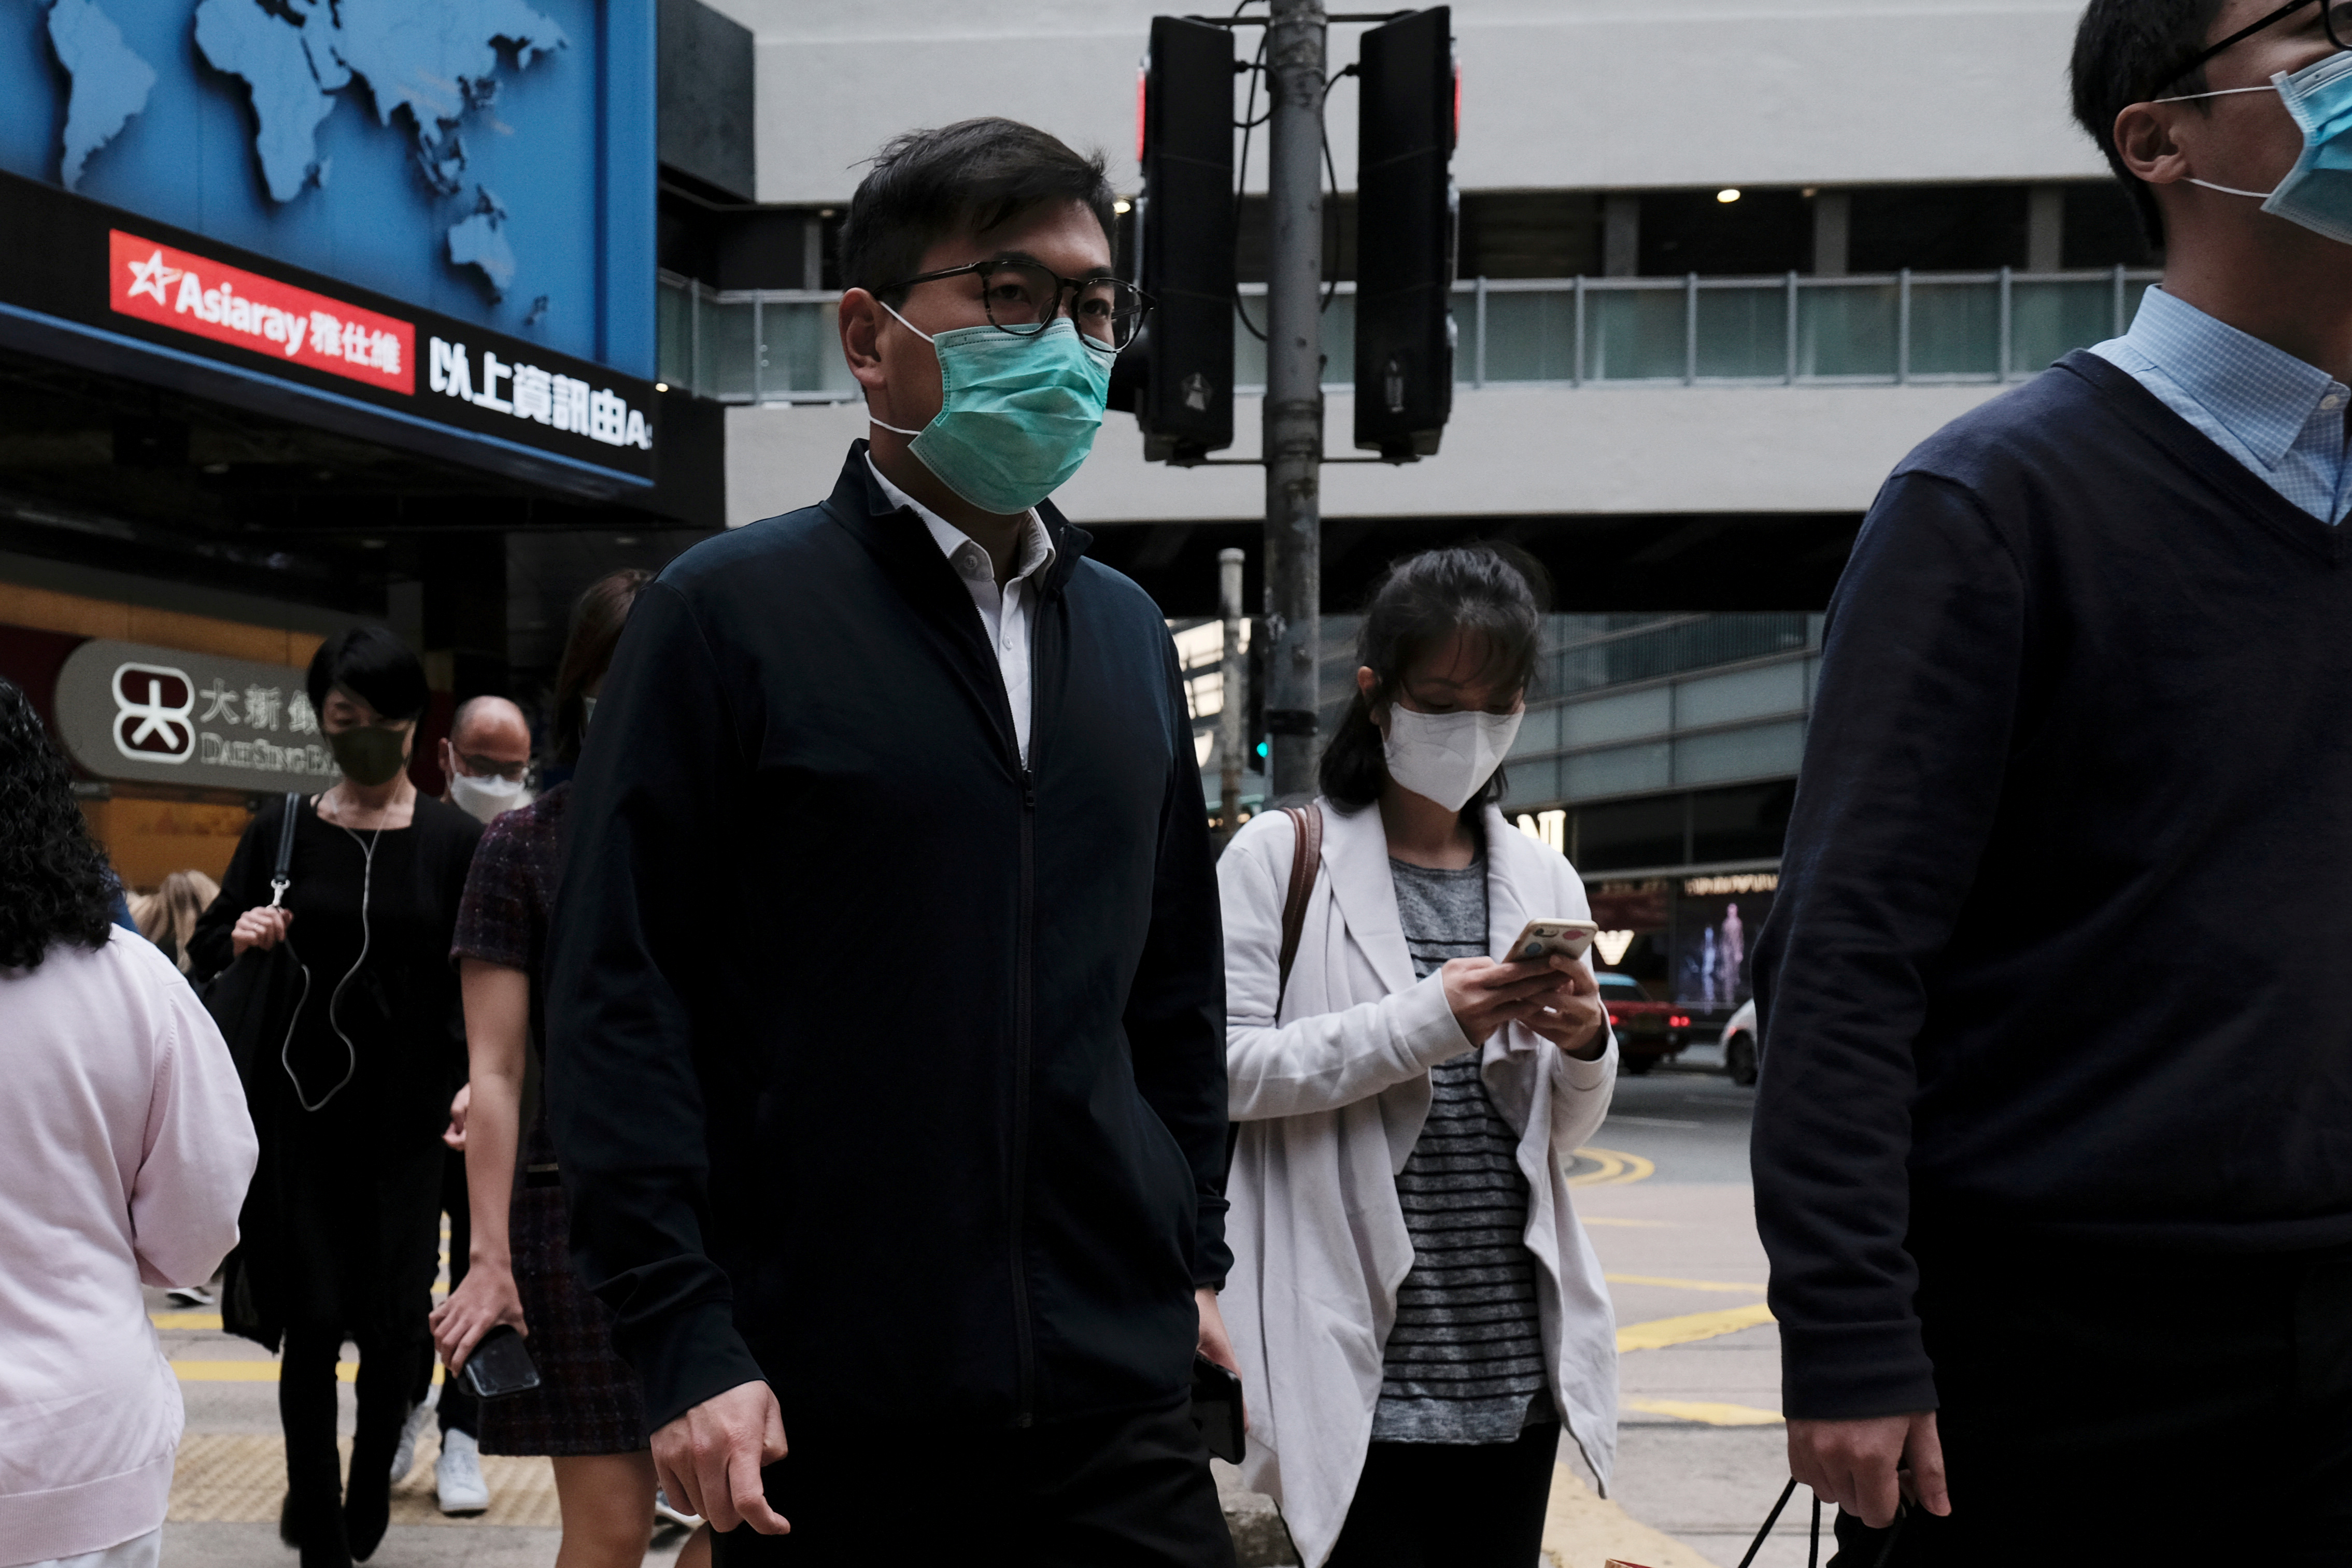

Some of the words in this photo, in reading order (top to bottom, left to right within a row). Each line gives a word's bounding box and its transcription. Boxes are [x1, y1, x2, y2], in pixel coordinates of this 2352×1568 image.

[175, 272, 308, 356] Asiaray
[310, 310, 401, 375] 雅仕維
